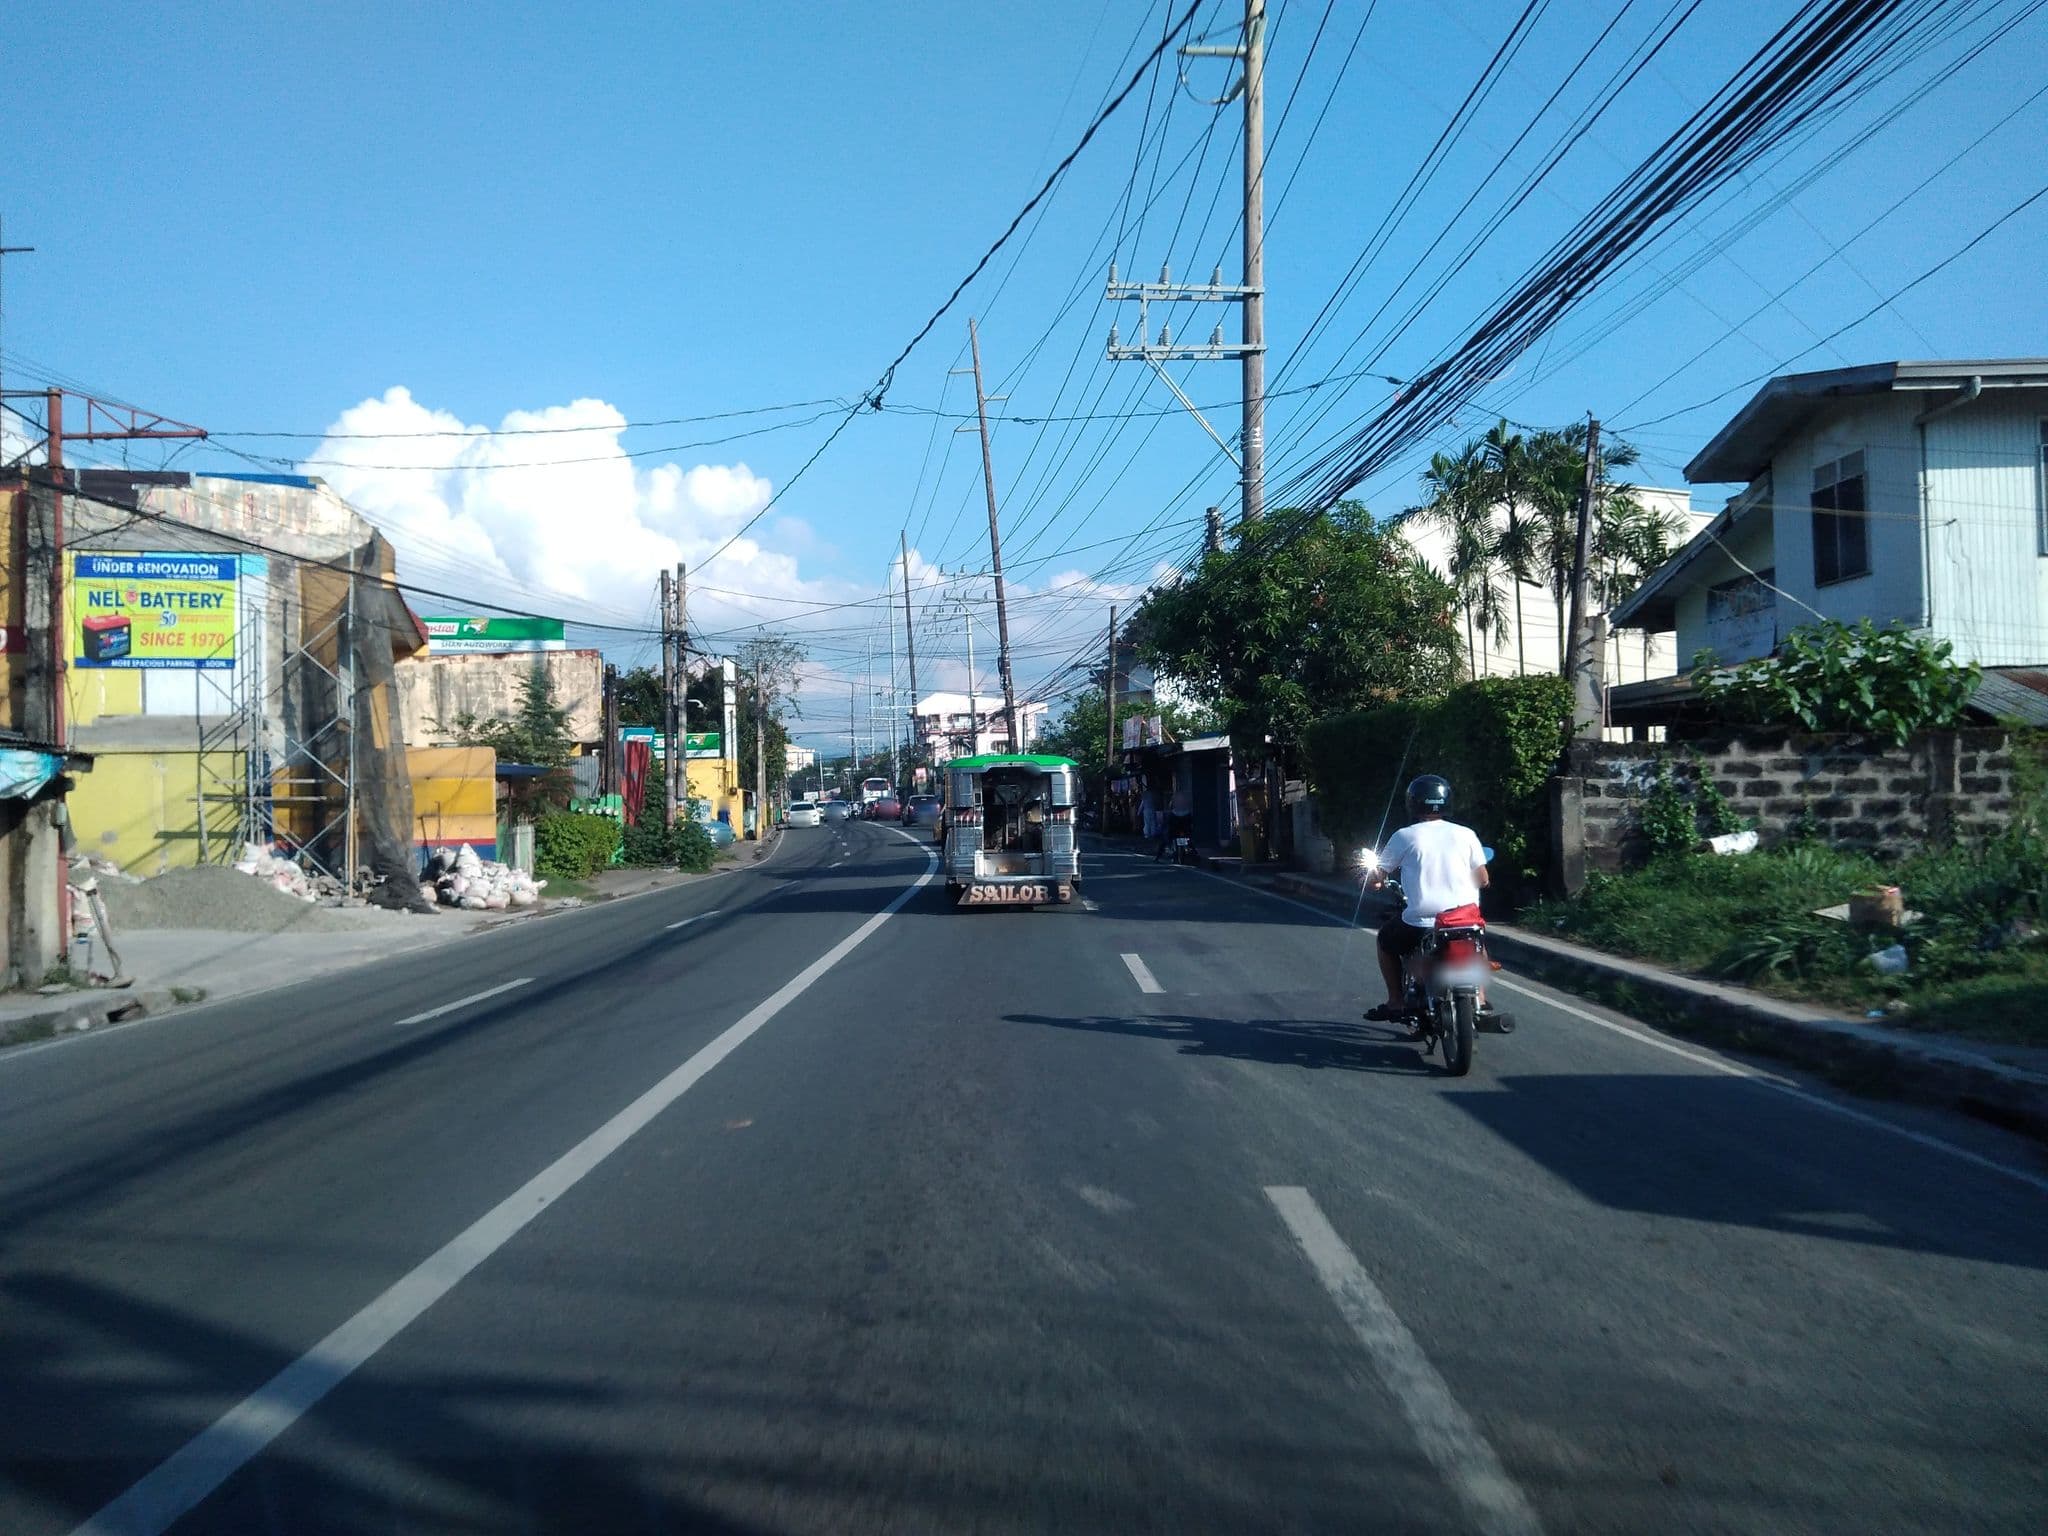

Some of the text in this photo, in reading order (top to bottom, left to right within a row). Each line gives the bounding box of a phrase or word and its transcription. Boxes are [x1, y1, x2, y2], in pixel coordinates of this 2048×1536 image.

[93, 561, 219, 575] UNDER RENOVATION
[88, 591, 224, 608] NEL BATTERY
[139, 632, 185, 646] SINCE
[191, 632, 226, 647] 1970
[111, 659, 129, 667] MORE
[131, 659, 165, 668] SPACIOUS
[969, 885, 1071, 903] SAILOR 5
